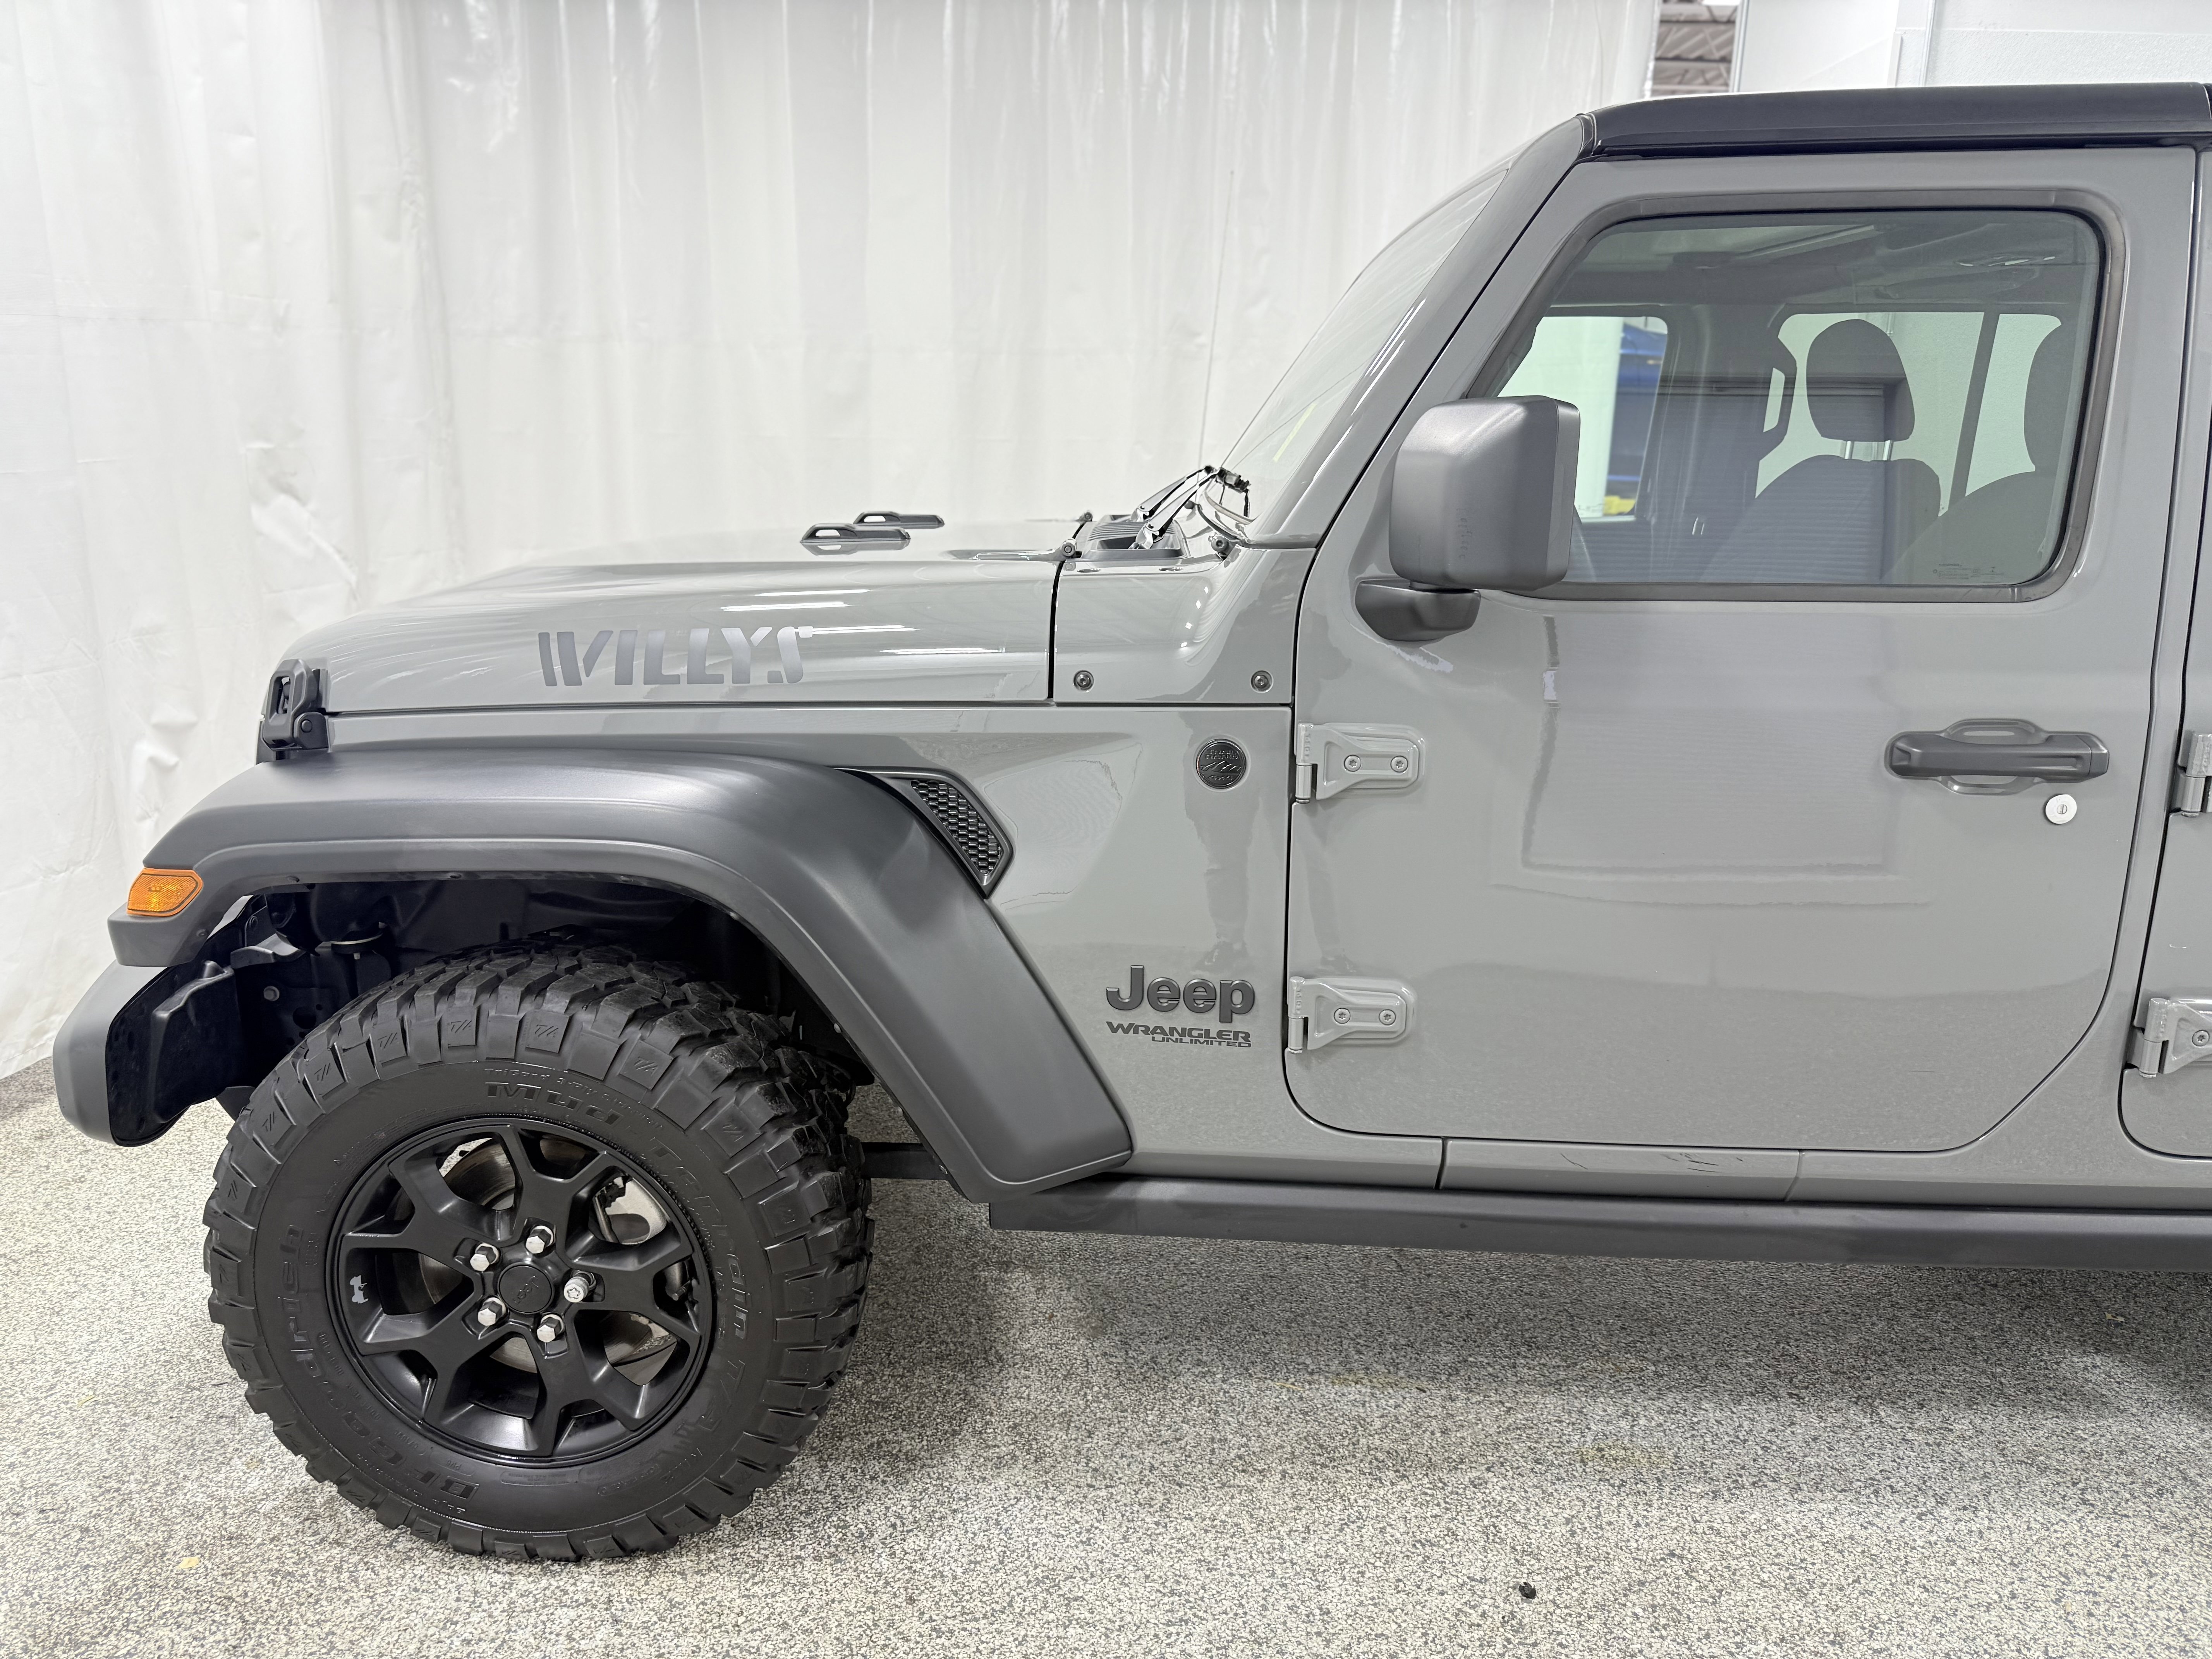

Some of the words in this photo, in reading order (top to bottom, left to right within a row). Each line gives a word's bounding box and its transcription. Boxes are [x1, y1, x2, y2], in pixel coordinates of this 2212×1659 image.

[539, 626, 813, 686] WILLYS
[1106, 965, 1255, 1023] Jeep
[1106, 1021, 1252, 1042] WRANGLER
[1151, 1036, 1251, 1048] UNLIMITED
